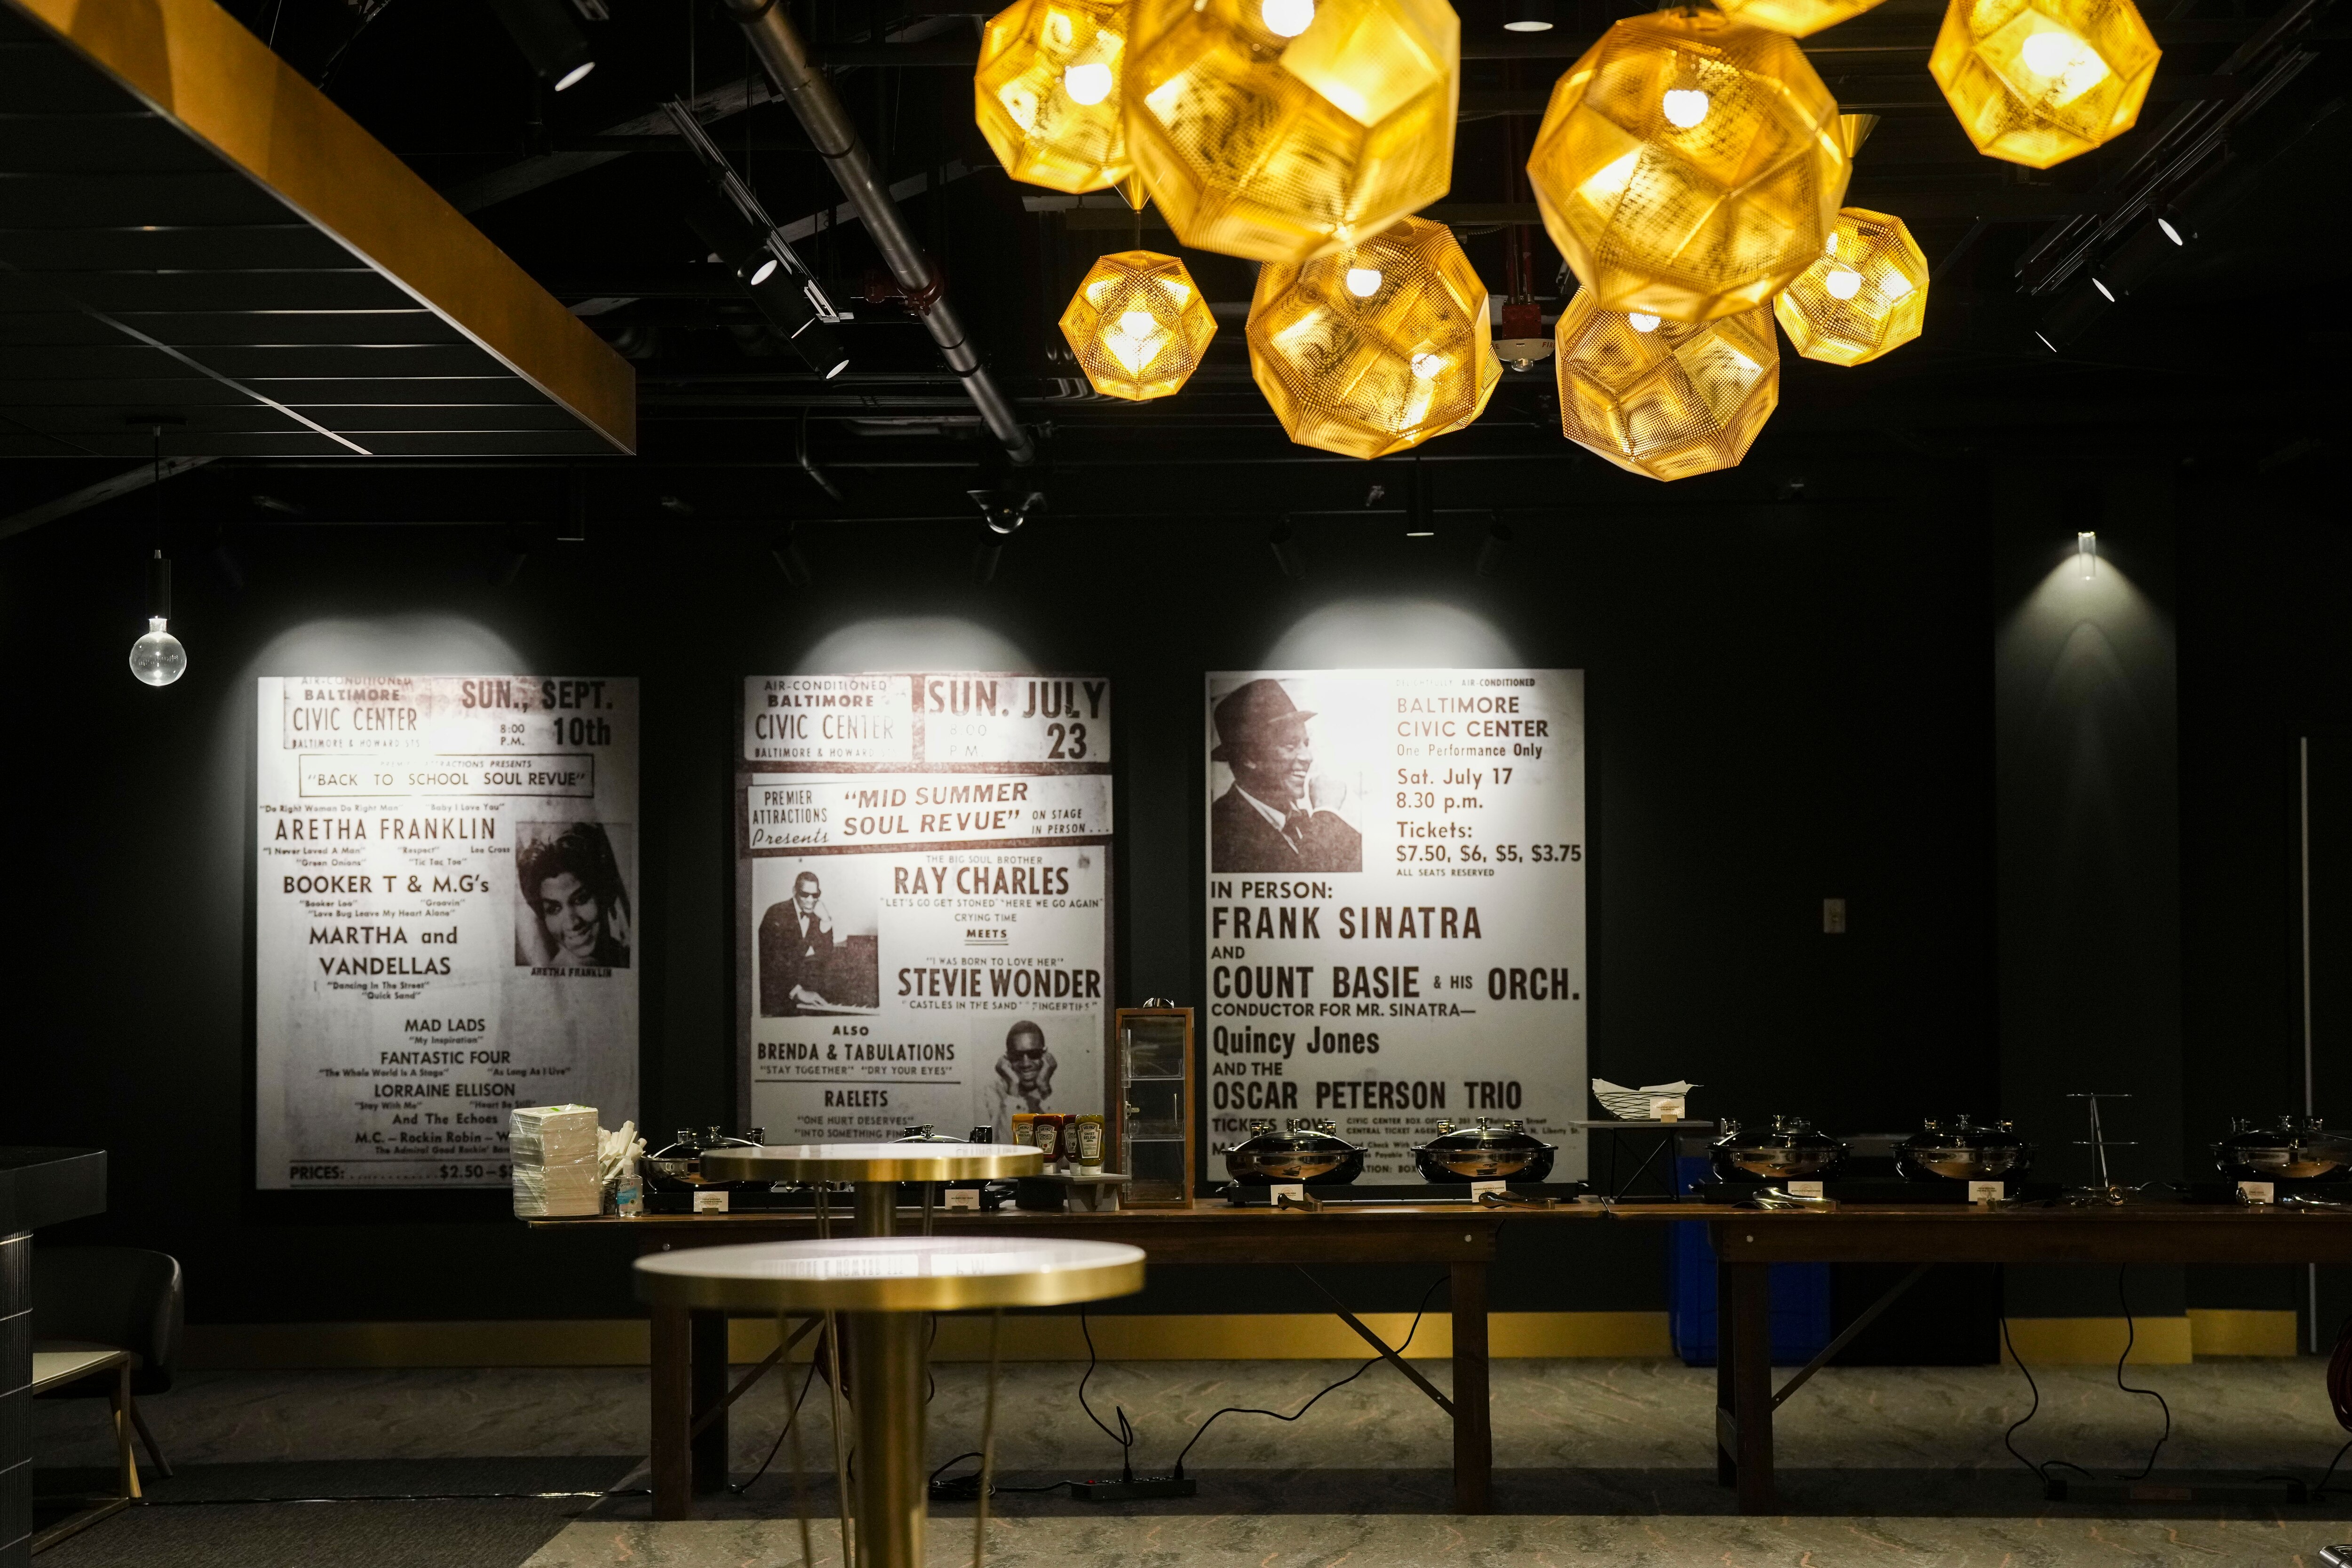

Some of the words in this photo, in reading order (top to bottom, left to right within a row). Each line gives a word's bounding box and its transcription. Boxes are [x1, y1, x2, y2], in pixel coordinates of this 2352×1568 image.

[764, 680, 886, 691] AIR-CONDITIONED
[305, 689, 400, 701] BALTIMORE
[462, 681, 532, 713] SUN.,
[541, 680, 613, 710] SEPT.
[767, 694, 874, 707] BALTIMORE
[929, 681, 1009, 718] SUN.
[1024, 678, 1108, 719] JULY
[1398, 697, 1519, 713] BALTIMORE
[293, 707, 340, 731] CIVIC
[354, 707, 417, 730] CENTER
[755, 713, 808, 740] CIVIC
[823, 714, 894, 740] CENTER
[500, 724, 525, 734] 8:00
[554, 716, 611, 746] 10th
[1397, 721, 1455, 737] CIVIC
[1467, 720, 1549, 737] CENTER
[501, 736, 524, 746] P.M.
[1047, 722, 1087, 760] 23
[1397, 744, 1419, 756] One
[1429, 744, 1505, 756] Performance
[1513, 743, 1542, 760] Only
[374, 774, 393, 785] TO
[409, 773, 469, 785] SCHOOL
[484, 772, 522, 785] SOUL
[1398, 768, 1433, 784] Sat.
[1443, 768, 1482, 790] July
[1493, 768, 1513, 784] 17
[764, 790, 811, 806] PREMIER
[915, 782, 1028, 805] SUMMER
[1397, 792, 1434, 808] 8.30
[1445, 797, 1483, 814] p.m.
[753, 808, 826, 824] ATTRACTIONS
[1033, 810, 1046, 820] ON
[1052, 808, 1081, 819] STAGE
[275, 819, 366, 840] ARETHA
[381, 818, 494, 839] FRANKLIN
[843, 815, 909, 836] SOUL
[1397, 821, 1472, 838] Tickets:
[752, 828, 831, 848] Presents
[997, 856, 1042, 864] BROTHER
[1397, 845, 1451, 863] $7.50,
[1461, 845, 1486, 863] $6,
[1496, 845, 1523, 863] $5,
[1532, 844, 1581, 863] $3.75
[284, 876, 372, 894] BOOKER
[383, 876, 397, 893] T
[407, 875, 421, 893] &
[433, 874, 489, 893] M.G's
[895, 867, 947, 895] RAY
[957, 867, 1069, 895] CHARLES
[1211, 881, 1232, 898] IN
[1242, 881, 1332, 899] PERSON:
[934, 899, 953, 907] GET
[1052, 899, 1065, 908] GO
[954, 913, 990, 922] CRYING
[1213, 907, 1320, 939] FRANK
[1339, 907, 1482, 939] SINATRA
[309, 927, 408, 944] MARTHA
[421, 926, 457, 944] and
[967, 929, 1007, 938] MEETS
[1211, 946, 1245, 959] AND
[319, 957, 451, 976] VANDELLAS
[991, 958, 1003, 966] TO
[1007, 958, 1033, 966] LOVE
[898, 968, 981, 997] STEVIE
[989, 969, 1101, 998] WONDER
[1213, 966, 1314, 999] COUNT
[1333, 966, 1420, 999] BASIE
[1433, 975, 1441, 989] &
[1450, 975, 1473, 989] HIS
[1488, 967, 1580, 1001] ORCH.
[1211, 1003, 1314, 1017] CONDUCTOR
[1319, 1003, 1351, 1016] FOR
[1356, 1003, 1384, 1016] MR.
[405, 1019, 441, 1032] MAD
[448, 1019, 485, 1032] LADS
[832, 1025, 869, 1036] ALSO
[1213, 1025, 1295, 1060] Quincy
[1306, 1026, 1380, 1054] Jones
[381, 1051, 464, 1065] FANTASTIC
[470, 1050, 510, 1064] FOUR
[757, 1043, 819, 1061] BRENDA
[826, 1044, 837, 1061] &
[844, 1044, 954, 1061] TABULATIONS
[891, 1066, 917, 1075] YOUR
[1212, 1062, 1247, 1076] AND
[1251, 1062, 1283, 1076] THE
[374, 1084, 450, 1098] LORRAINE
[455, 1083, 516, 1097] ELLISON
[825, 1090, 888, 1108] RAELETS
[1213, 1081, 1298, 1110] OSCAR
[1316, 1081, 1446, 1110] PETERSON
[1463, 1081, 1522, 1110] TRIO
[392, 1113, 418, 1125] And
[425, 1113, 449, 1125] The
[456, 1113, 498, 1125] Echoes
[827, 1116, 854, 1125] HURT
[290, 1165, 345, 1180] PRICES:
